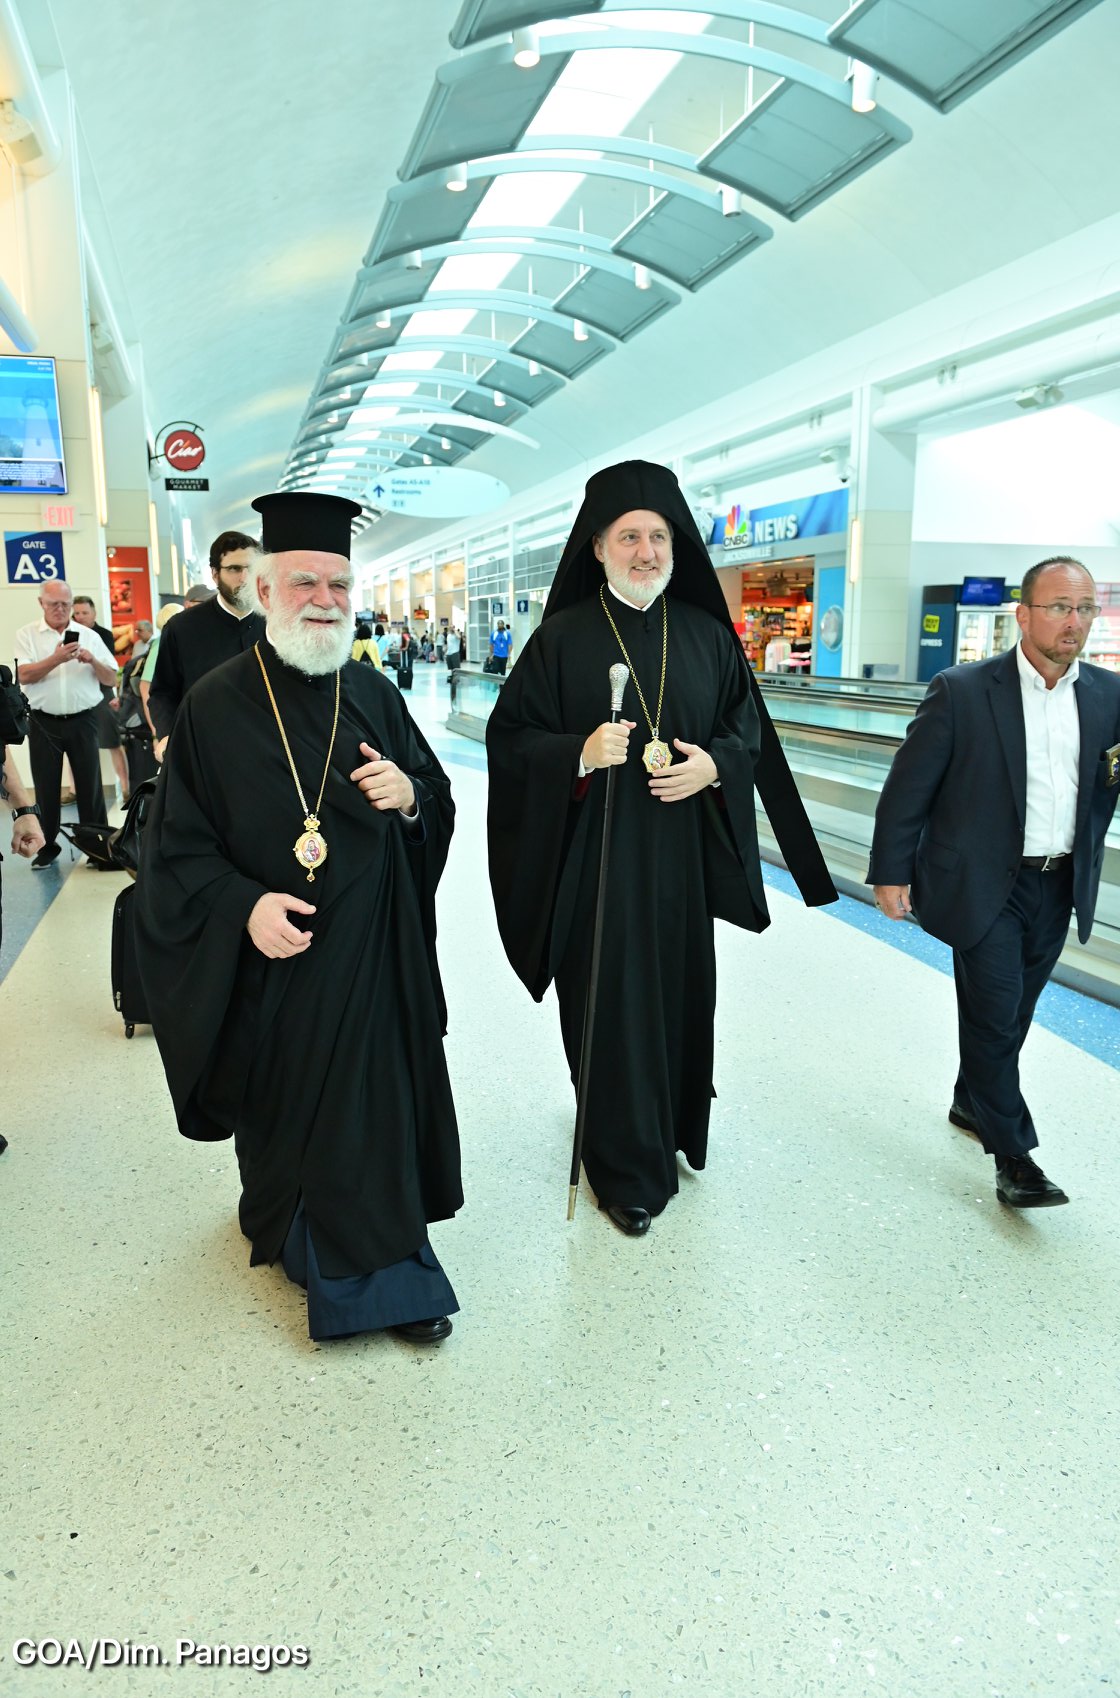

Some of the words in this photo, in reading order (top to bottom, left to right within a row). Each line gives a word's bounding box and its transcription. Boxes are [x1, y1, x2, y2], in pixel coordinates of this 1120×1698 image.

[168, 438, 203, 459] Ciao
[47, 506, 75, 528] EXIT
[754, 514, 798, 543] NEWS
[22, 540, 46, 549] GATE
[723, 533, 748, 548] CNBC
[13, 553, 59, 580] A3
